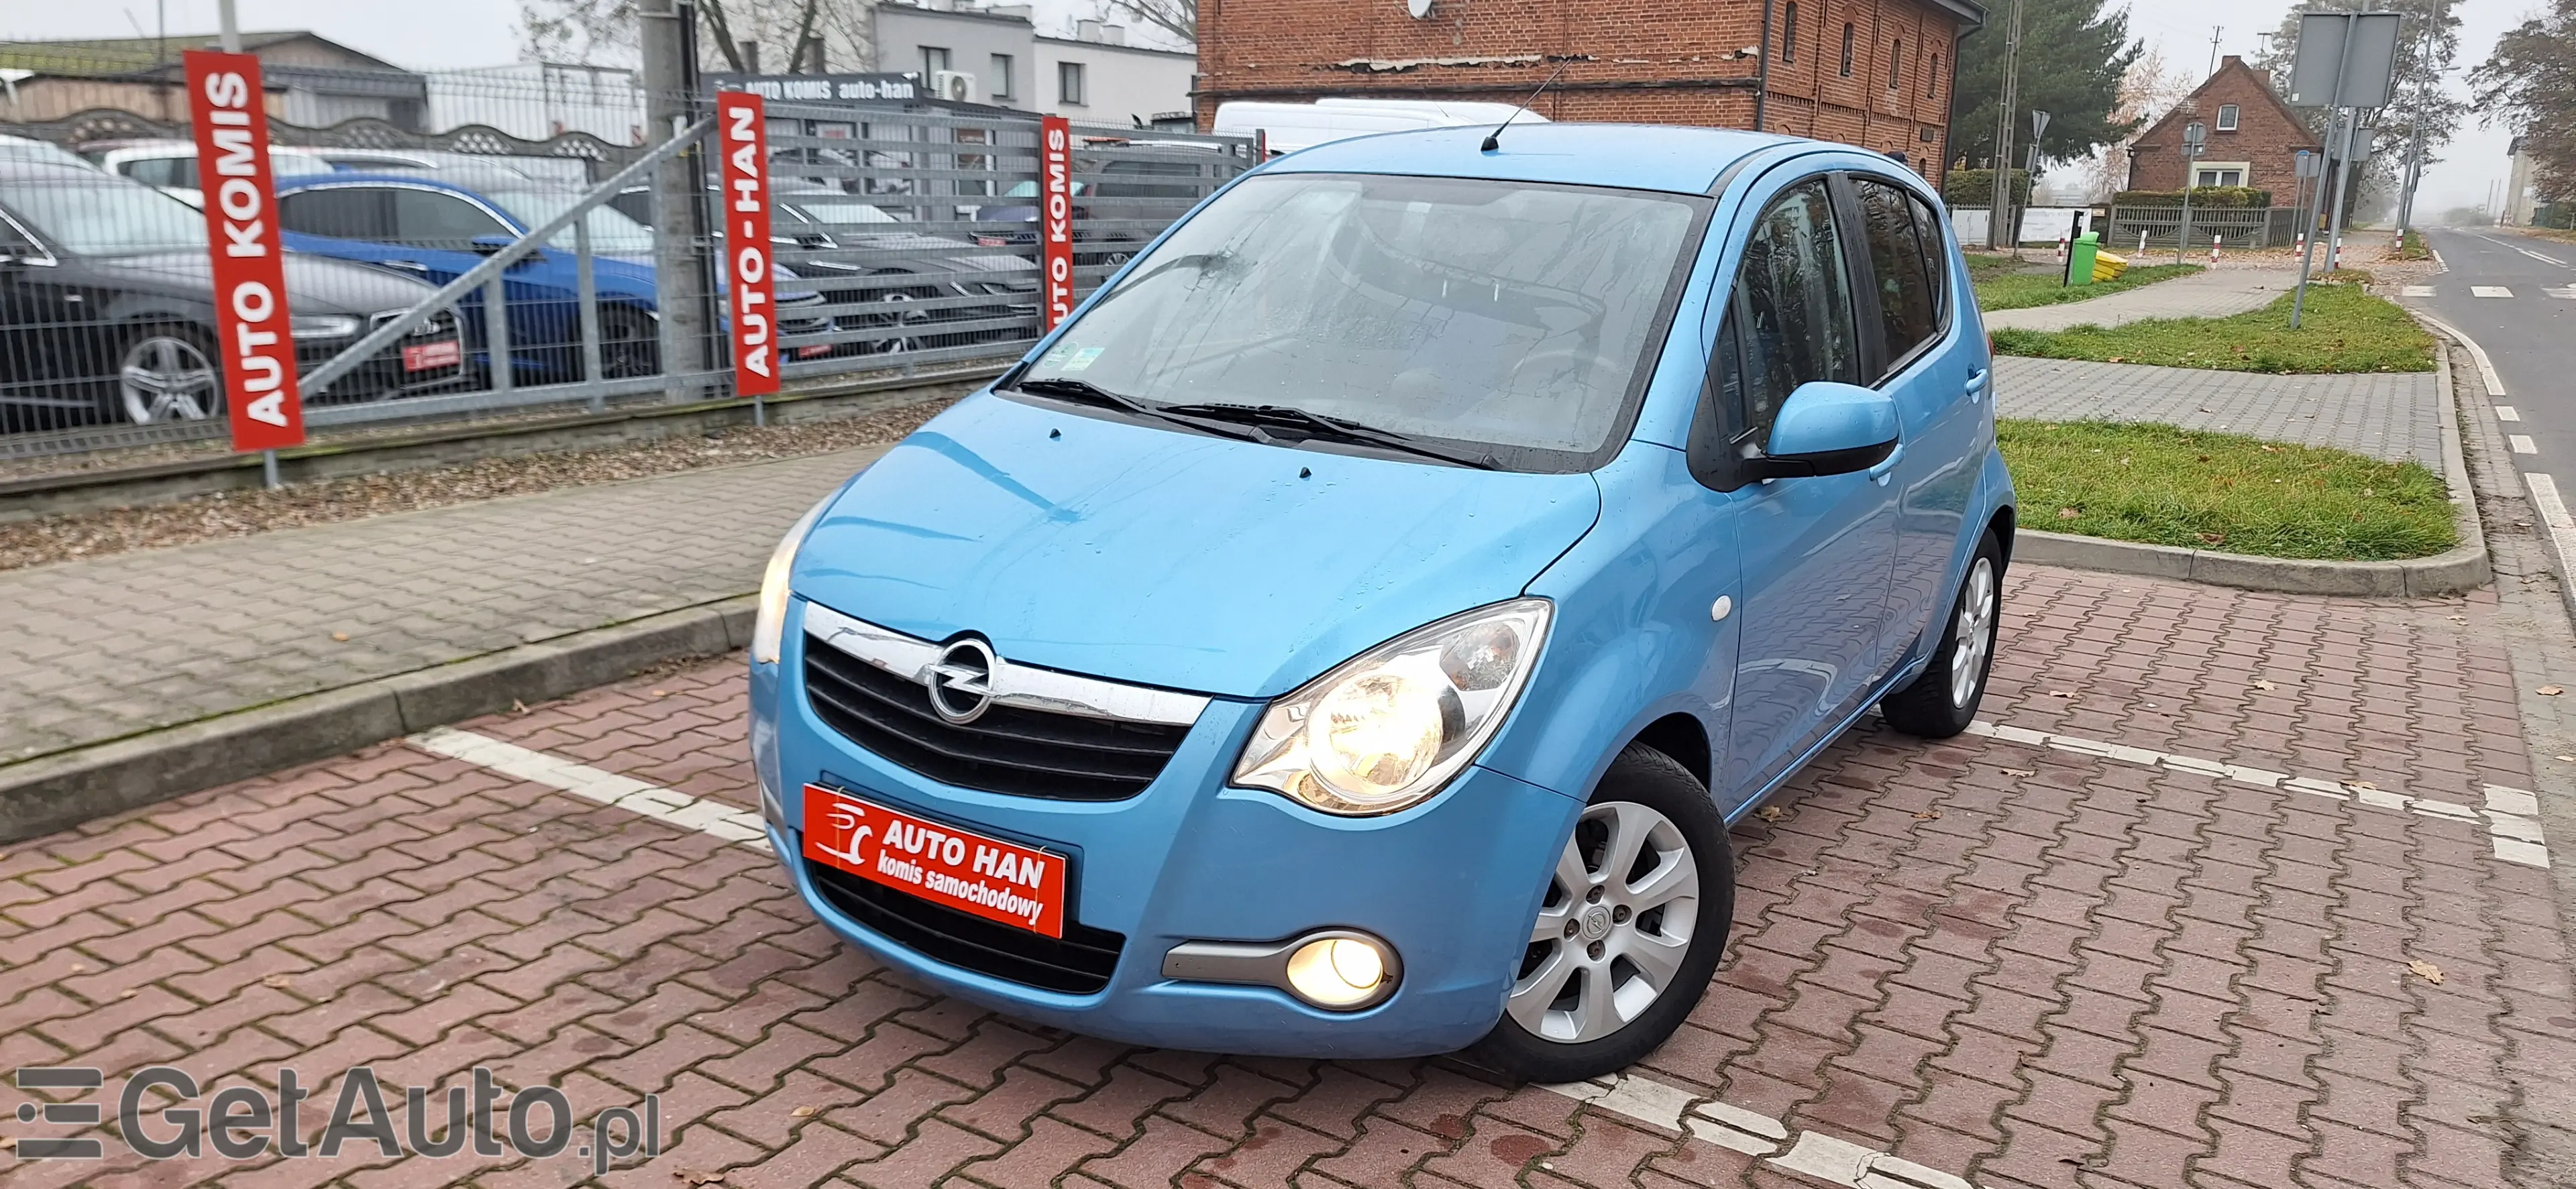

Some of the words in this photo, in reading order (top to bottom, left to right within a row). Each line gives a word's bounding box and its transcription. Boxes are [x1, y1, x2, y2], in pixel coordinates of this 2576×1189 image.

[745, 80, 782, 100] AUTO
[782, 80, 832, 100] KOMIS
[838, 79, 914, 100] auto-han
[205, 72, 267, 258] KOMIS
[1048, 129, 1067, 243] KOMIS
[1051, 256, 1069, 326] UTO
[232, 281, 288, 427] AUTO
[877, 849, 924, 885] komis
[924, 870, 1044, 925] samochodowy
[881, 819, 966, 866] AUTO
[972, 844, 1045, 889] HAN
